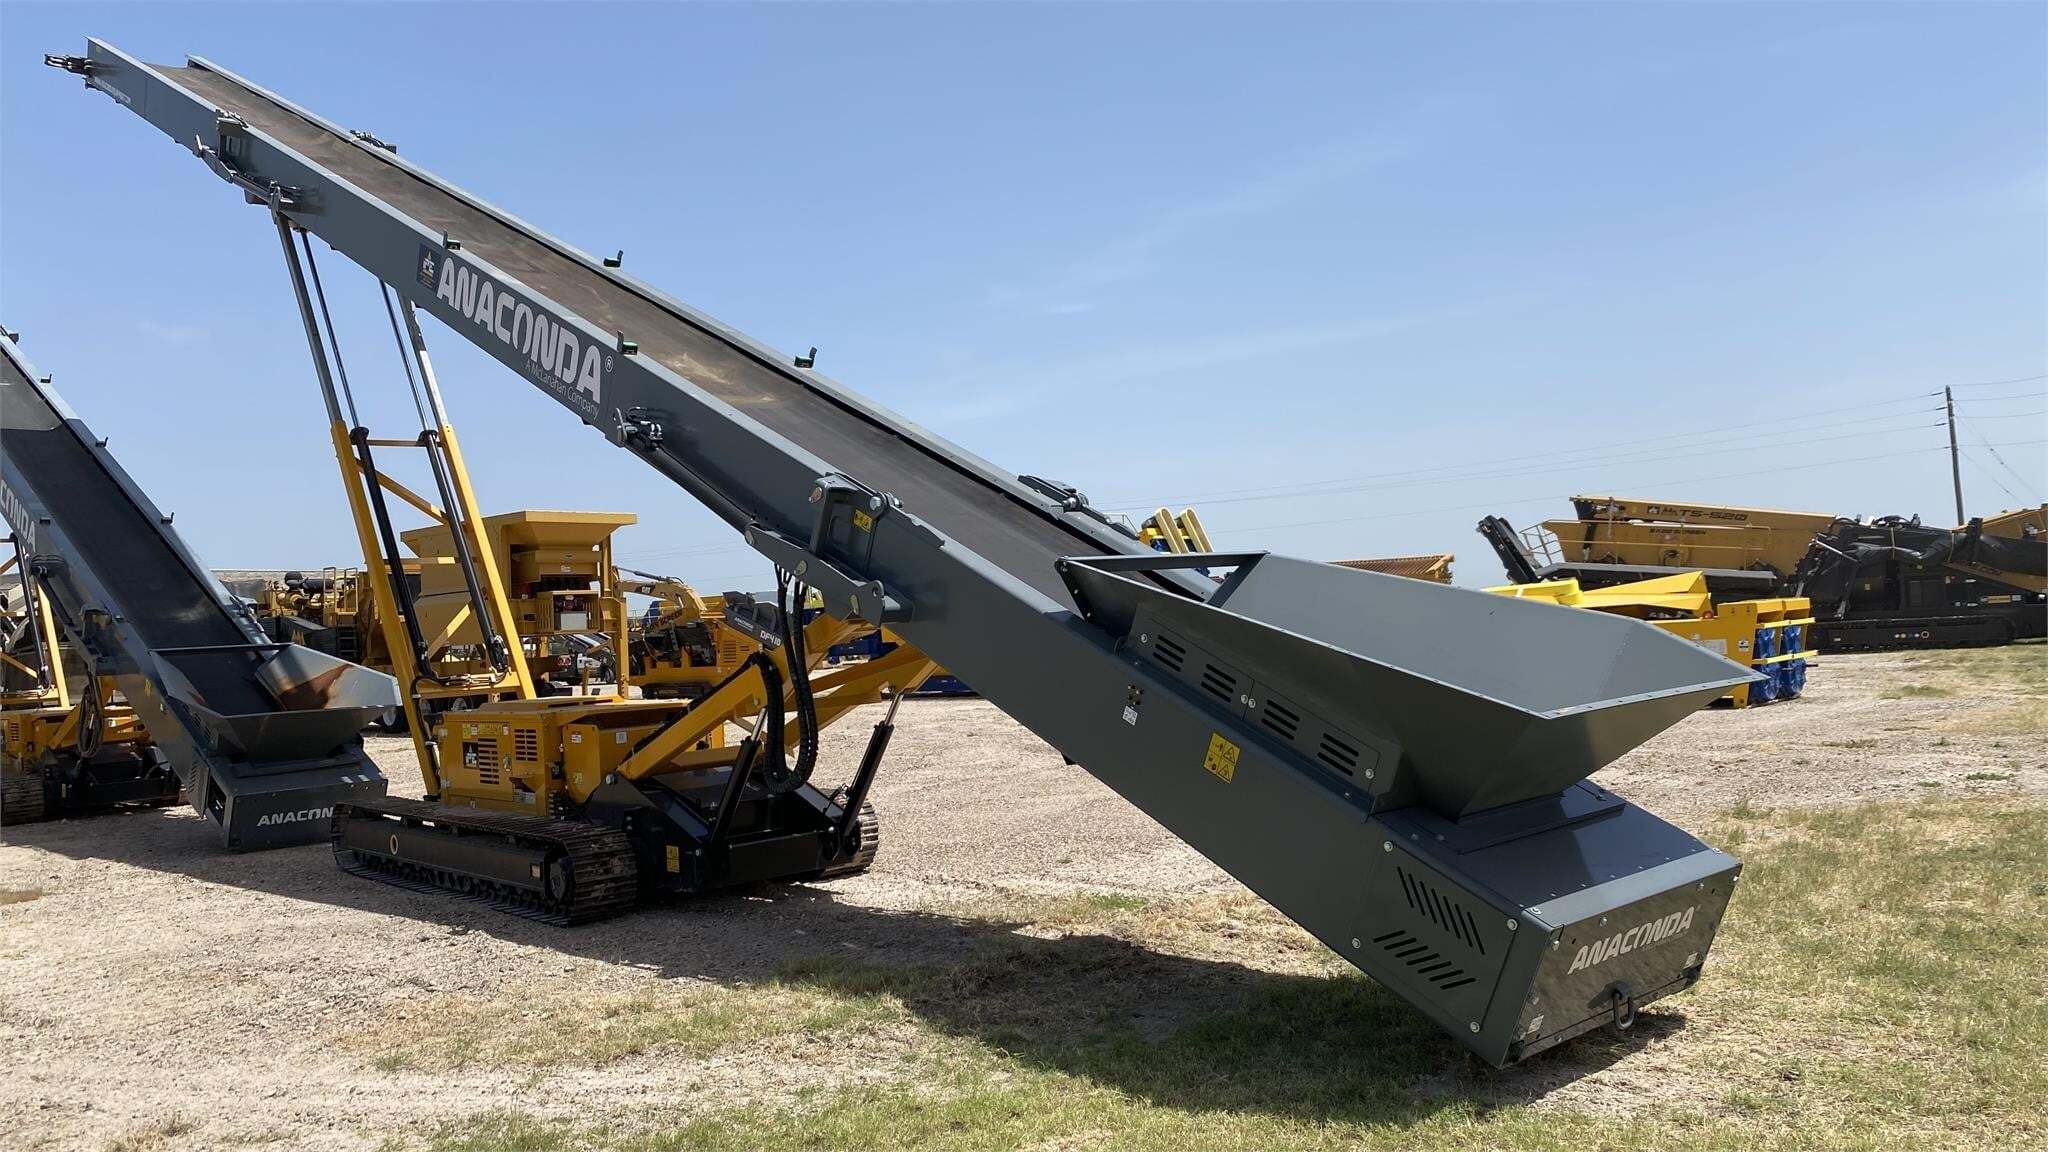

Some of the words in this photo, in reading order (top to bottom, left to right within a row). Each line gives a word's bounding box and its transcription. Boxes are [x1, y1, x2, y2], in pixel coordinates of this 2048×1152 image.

[436, 257, 600, 404] ANACONDA
[568, 386, 600, 420] Company
[1567, 906, 1695, 975] ANACONDA
